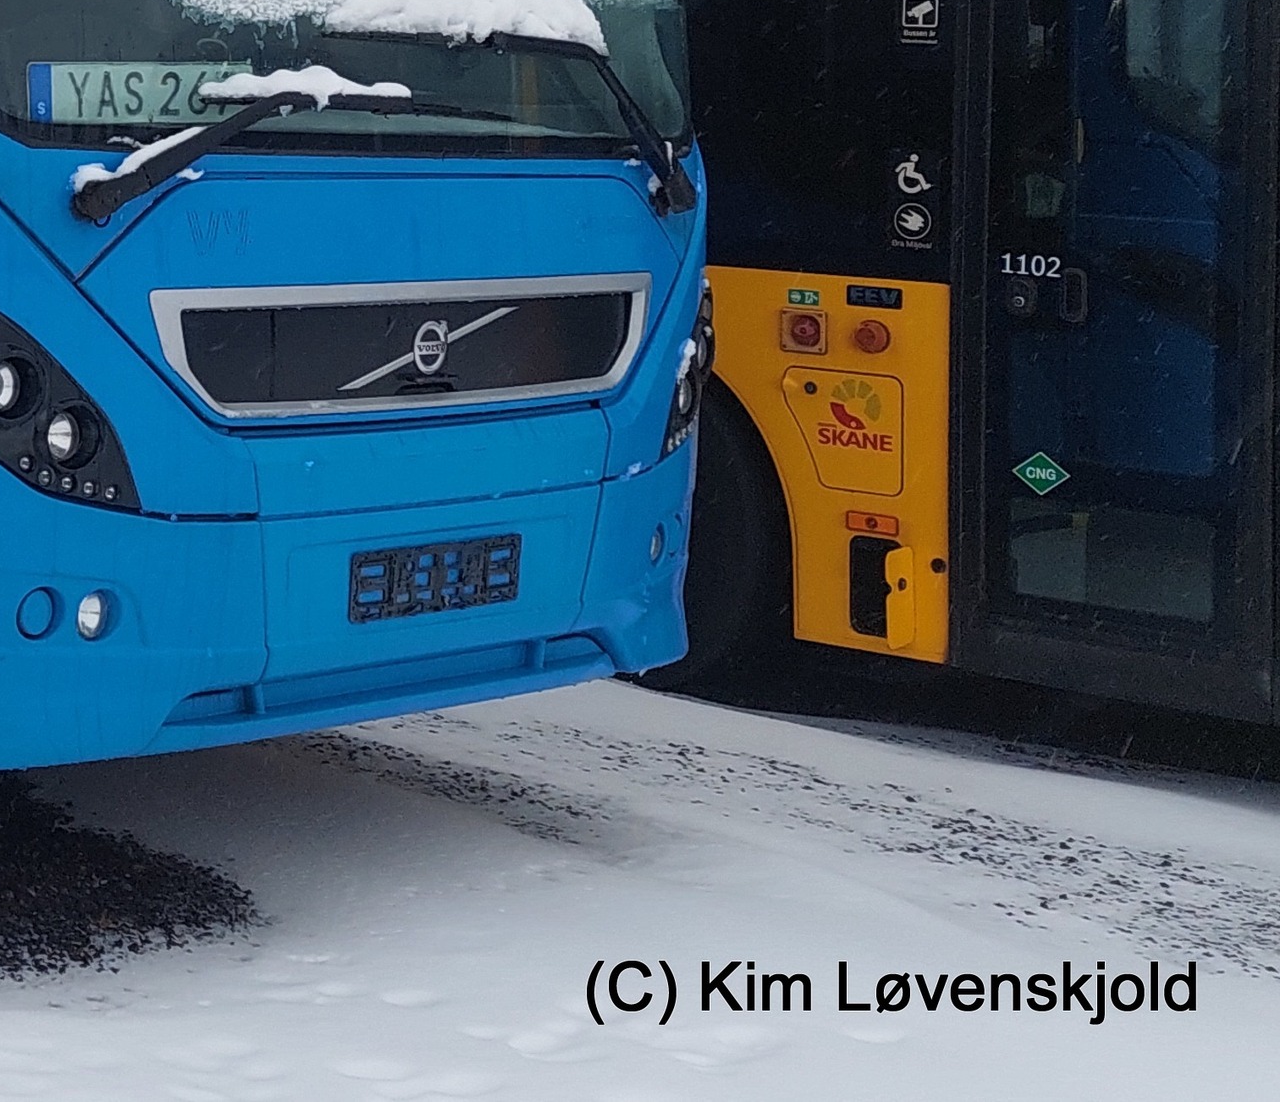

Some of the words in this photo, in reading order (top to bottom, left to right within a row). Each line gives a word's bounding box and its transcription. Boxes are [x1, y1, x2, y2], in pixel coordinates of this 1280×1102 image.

[67, 71, 145, 118] YAS
[37, 102, 46, 115] S
[1000, 252, 1062, 278] 1102
[1025, 466, 1057, 481] CNG
